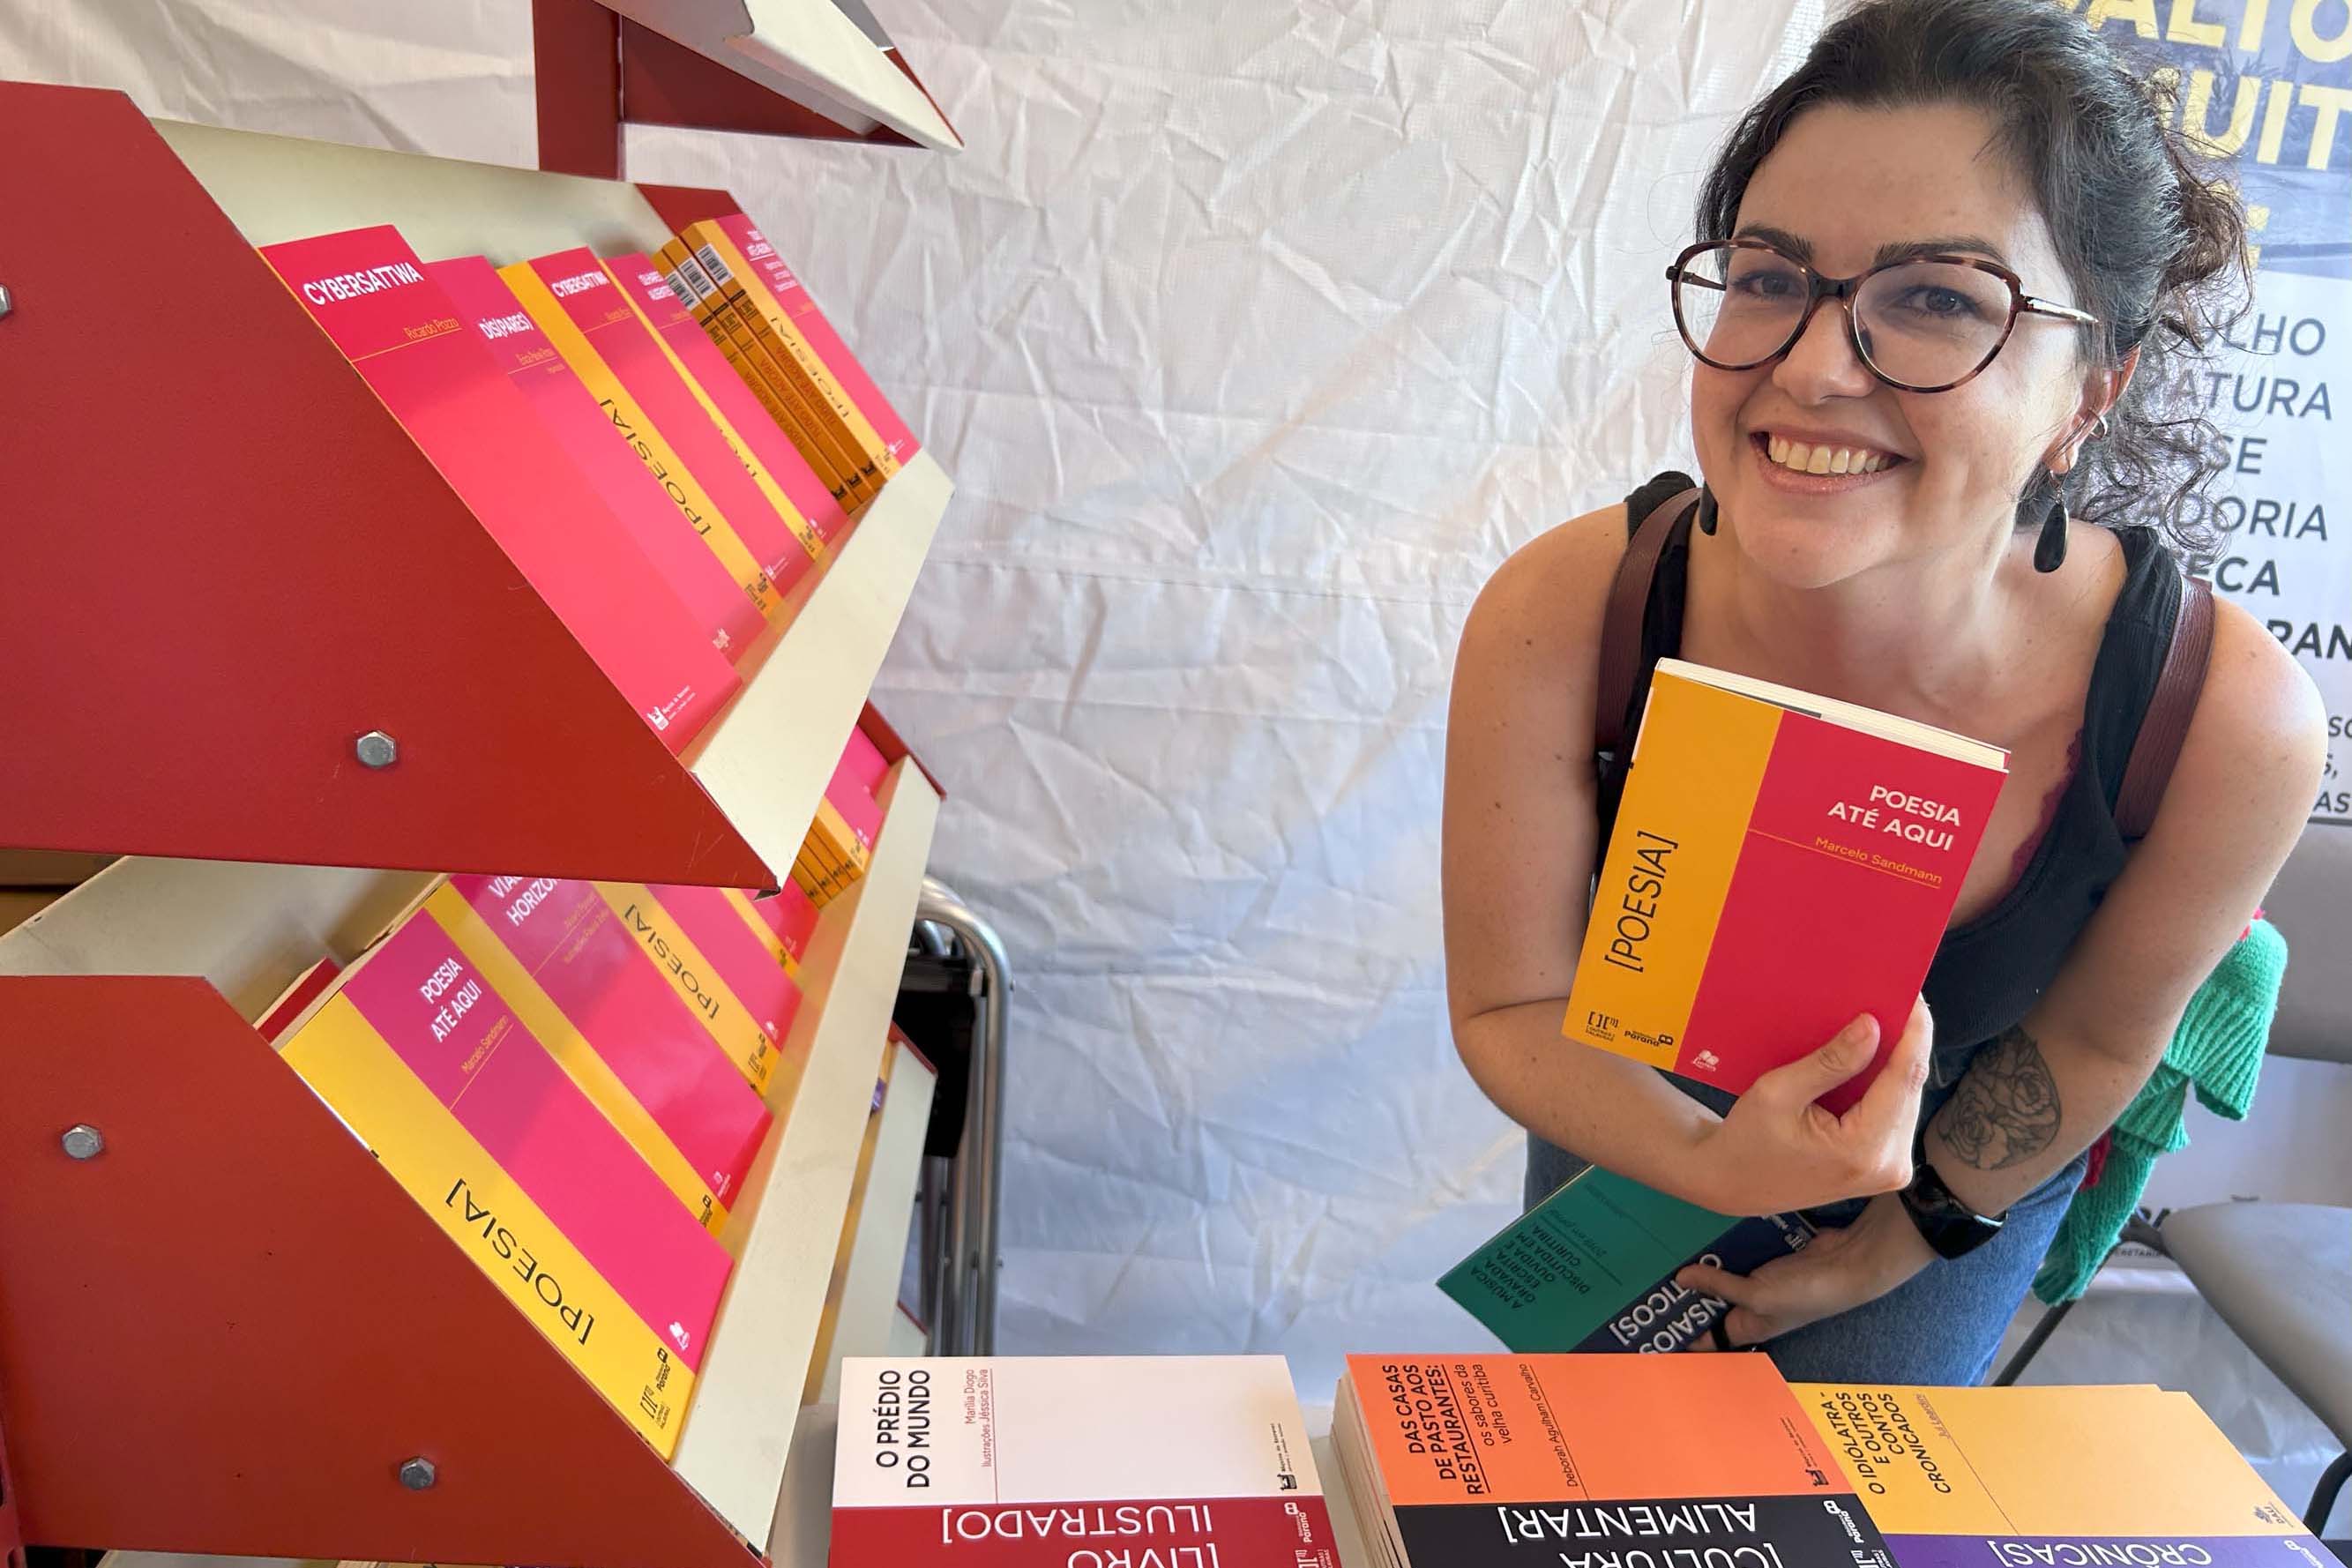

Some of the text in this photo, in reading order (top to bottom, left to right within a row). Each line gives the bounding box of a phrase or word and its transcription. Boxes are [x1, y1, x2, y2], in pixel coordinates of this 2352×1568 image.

[303, 262, 423, 305] CYBERSATTWA
[600, 399, 711, 535] [POESIA]
[1828, 801, 1953, 851] ATÉ AQUI
[1869, 785, 1960, 826] POESIA
[1815, 836, 1943, 884] Marcelo Sandmann
[1604, 831, 1678, 973] [POESIA]
[420, 958, 463, 1004] POESIA
[624, 903, 720, 1019] [POESIA]
[429, 979, 482, 1042] ATÉ AQUI
[461, 1015, 509, 1073] Marcelo Sandmann
[445, 1178, 594, 1346] [POESIA]
[1639, 1296, 1728, 1354] NSAIOS
[873, 1370, 900, 1467] O PRÉDIO
[907, 1370, 930, 1489] DO MUNDO
[964, 1369, 977, 1424] Marília Diogo
[977, 1369, 992, 1467] Ilustrações Jéssica Silva
[1383, 1365, 1425, 1452] DAS CASAS
[1403, 1365, 1456, 1479] DE PASTO AOS
[1425, 1365, 1484, 1494] RESTAURANTES:
[1454, 1364, 1494, 1446] os sabores da
[1473, 1364, 1512, 1444] velha curitiba
[1519, 1363, 1579, 1488] Deborah Agulham Carvalho
[1836, 1393, 1880, 1451] OUTROS
[1856, 1393, 1904, 1454] CONTOS
[1821, 1401, 1877, 1478] IDIÓLATRA
[1878, 1393, 1951, 1493] CRONICADOS
[1869, 1482, 1885, 1494] O
[943, 1505, 1213, 1543] ILUSTRADO]
[1067, 1542, 1220, 1568] [LIVRO
[1497, 1504, 1756, 1543] ALIMENTAR]
